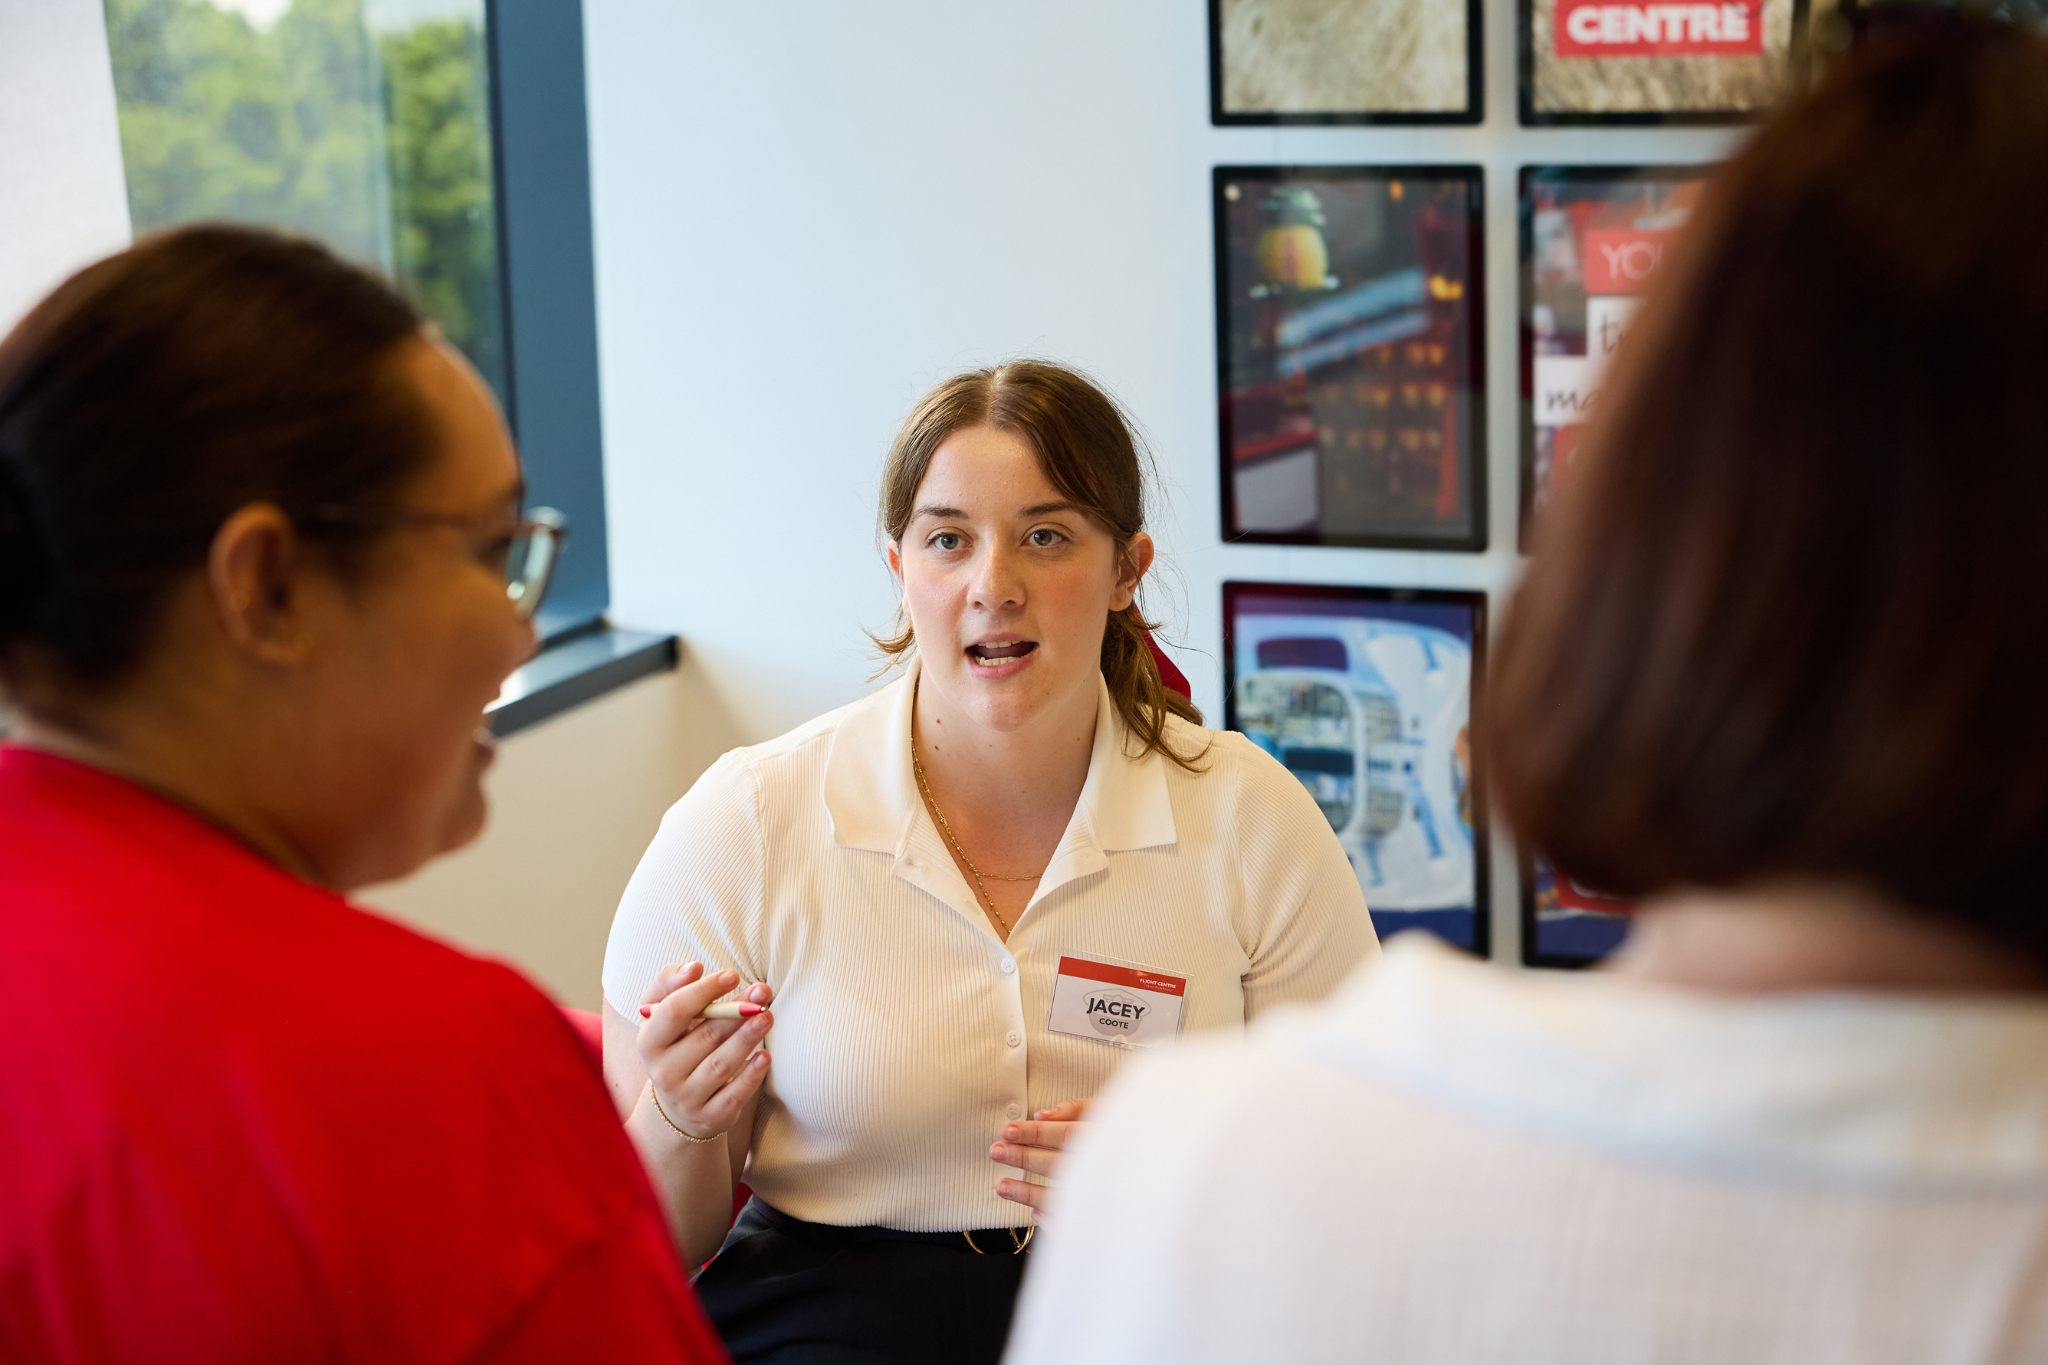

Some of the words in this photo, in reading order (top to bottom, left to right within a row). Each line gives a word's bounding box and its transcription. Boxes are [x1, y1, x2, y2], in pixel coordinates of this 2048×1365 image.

[1566, 4, 1749, 45] CENTRE
[1140, 978, 1157, 986] FLIGHT
[1157, 981, 1176, 989] CENTRE
[1086, 998, 1145, 1019] JACEY
[1099, 1017, 1129, 1029] COOTE
